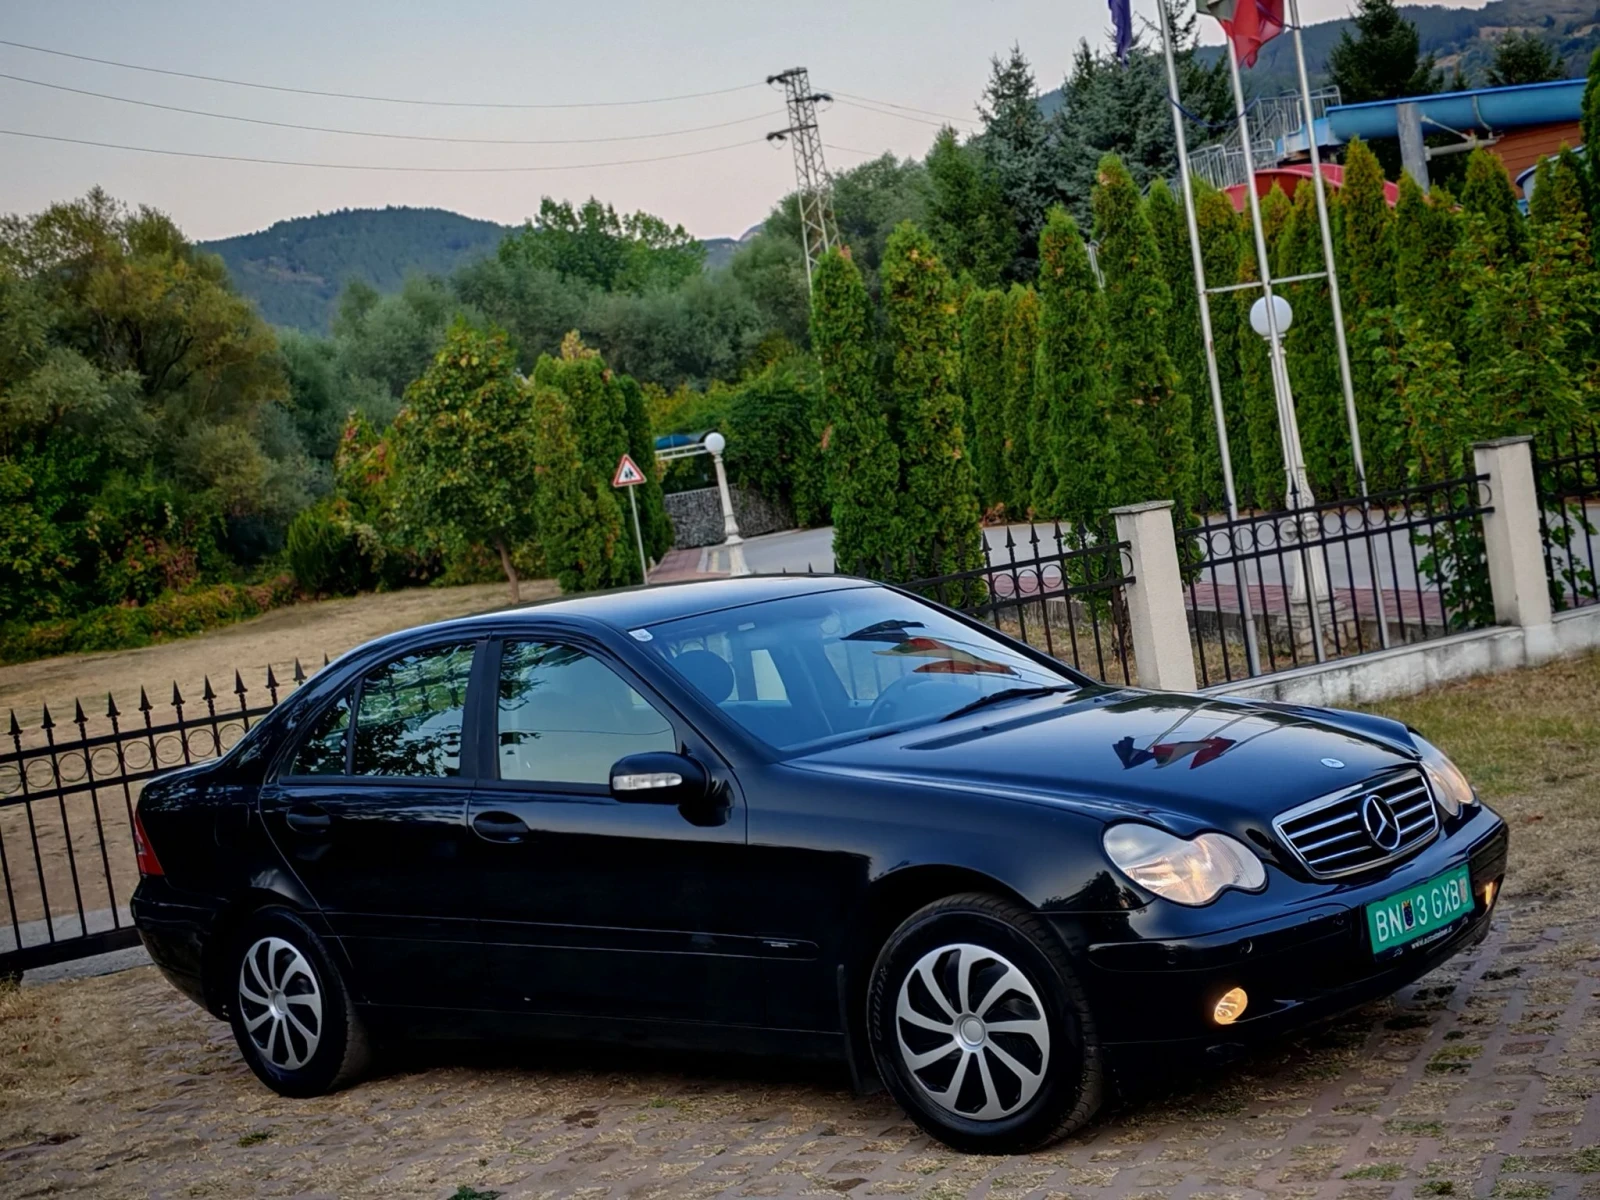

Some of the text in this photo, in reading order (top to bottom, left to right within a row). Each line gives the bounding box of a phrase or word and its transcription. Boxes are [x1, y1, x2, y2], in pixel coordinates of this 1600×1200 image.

[1375, 904, 1403, 943] BN
[1416, 894, 1428, 926] 3
[1431, 879, 1460, 919] GXB
